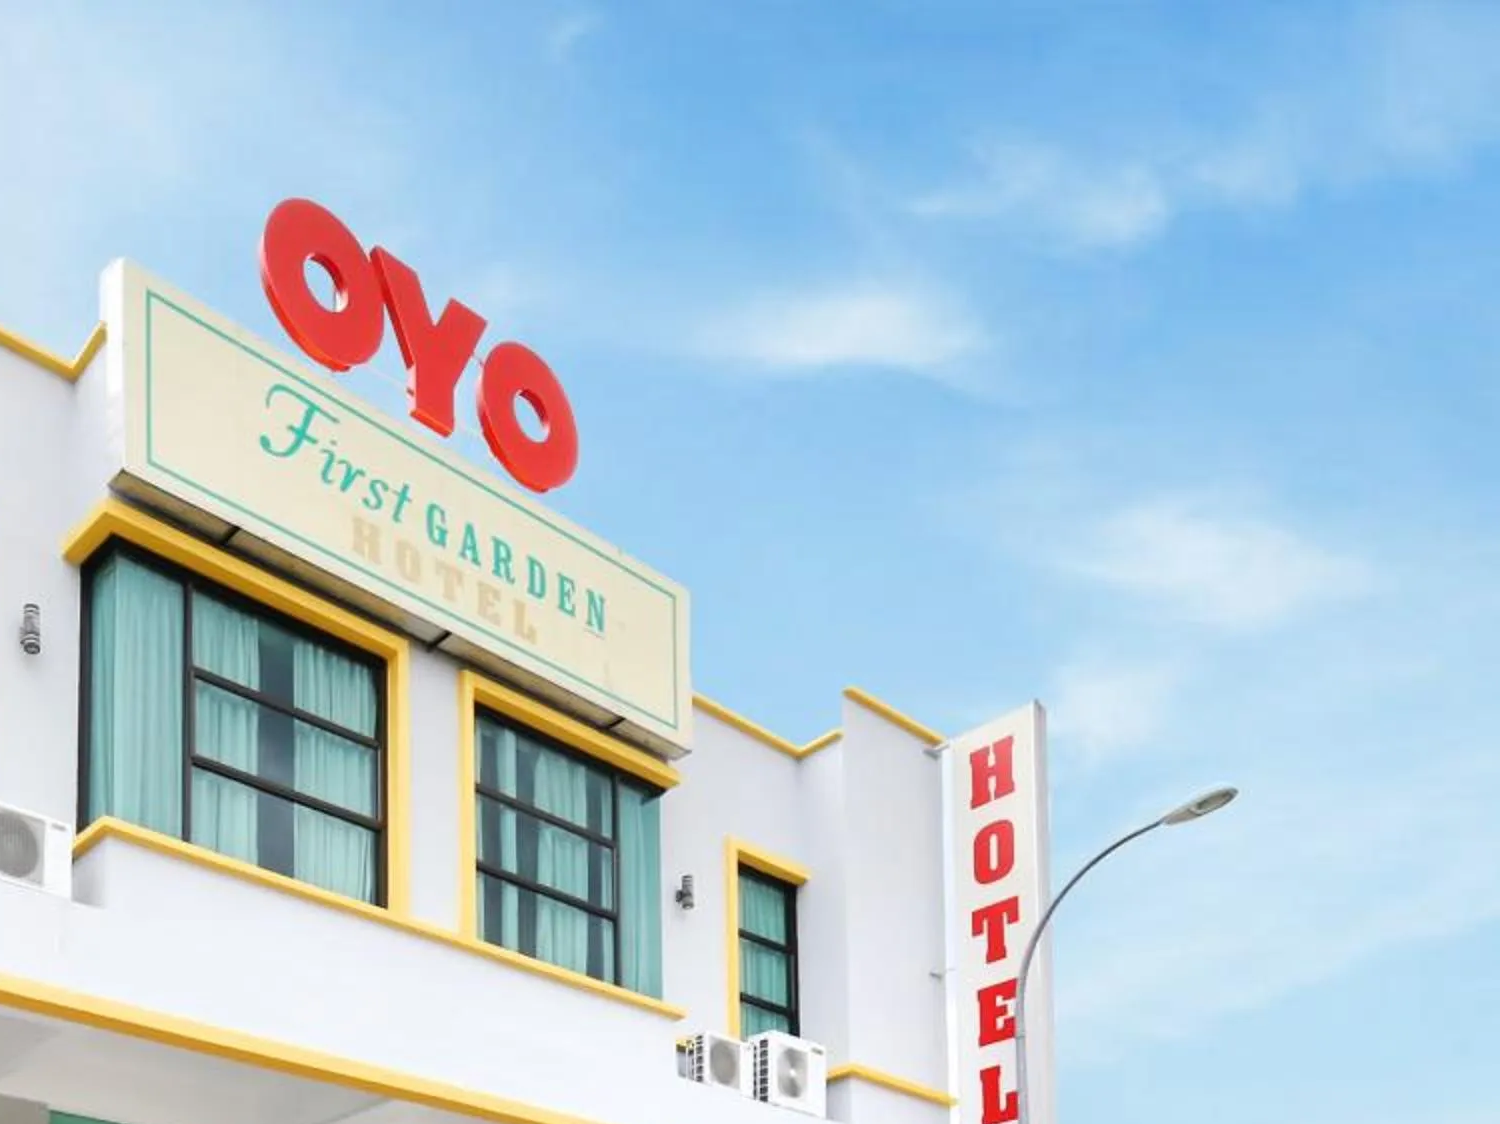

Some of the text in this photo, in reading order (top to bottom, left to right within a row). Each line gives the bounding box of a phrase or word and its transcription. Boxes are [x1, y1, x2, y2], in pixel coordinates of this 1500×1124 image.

[260, 197, 579, 494] OYO
[259, 383, 607, 635] First GARDEN
[350, 515, 538, 645] HOTEL
